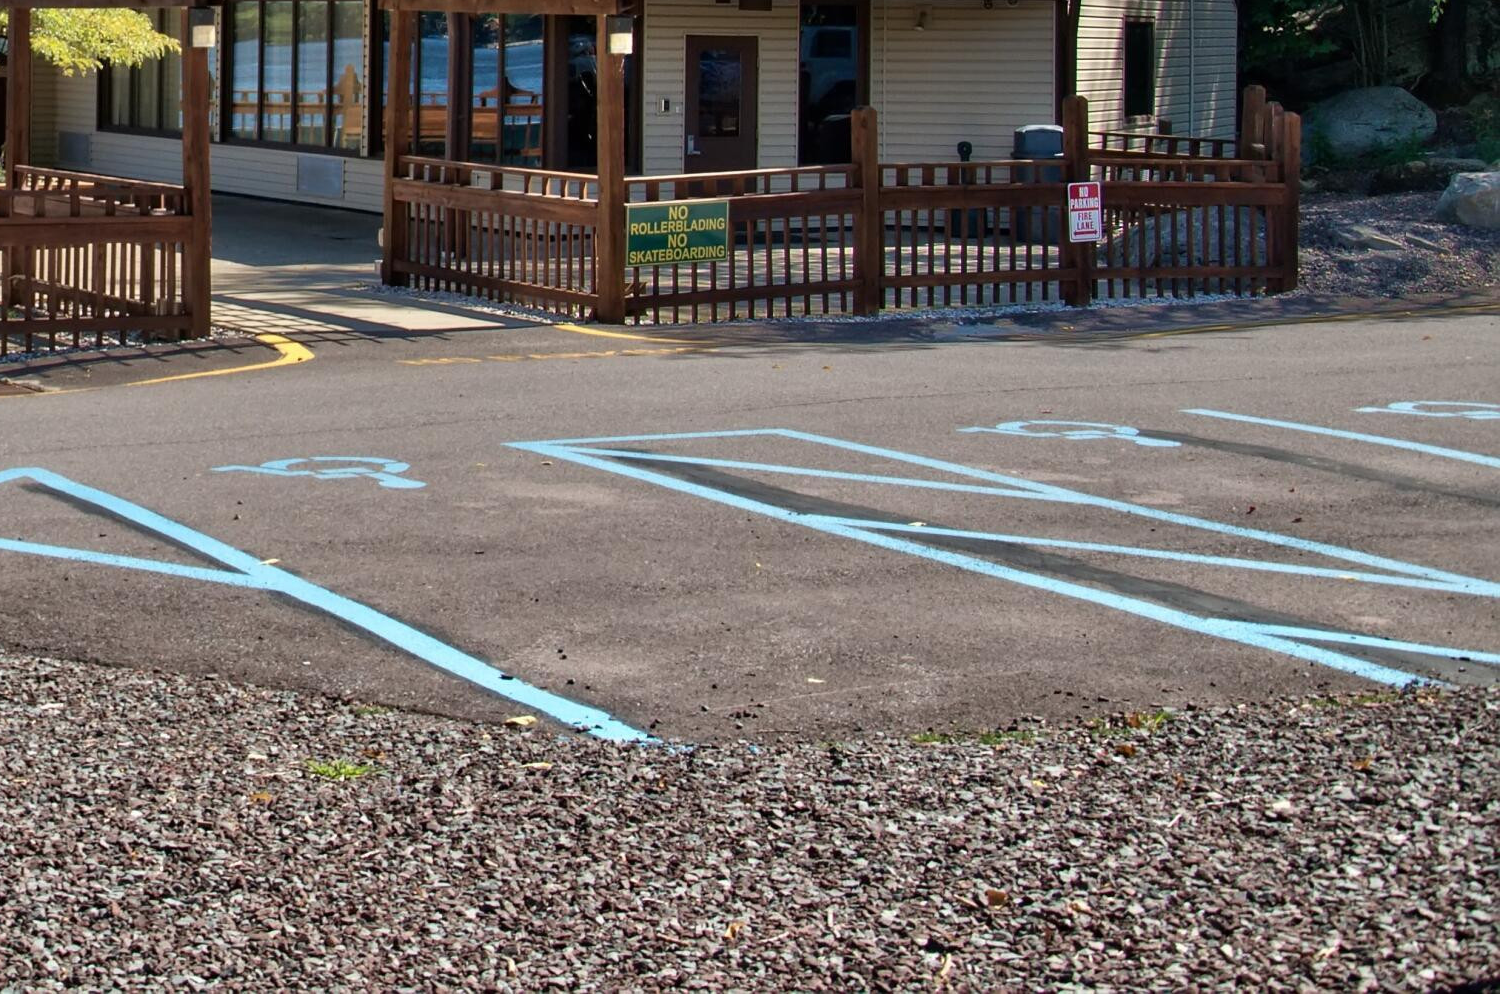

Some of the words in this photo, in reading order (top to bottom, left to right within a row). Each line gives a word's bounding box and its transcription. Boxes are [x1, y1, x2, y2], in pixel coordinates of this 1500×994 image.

[1079, 186, 1088, 197] NO
[1070, 197, 1099, 209] PARKING
[668, 205, 688, 220] NO
[630, 217, 725, 235] ROLLERBLADING
[667, 233, 688, 248] NO
[629, 245, 725, 263] SKATEBOARDING
